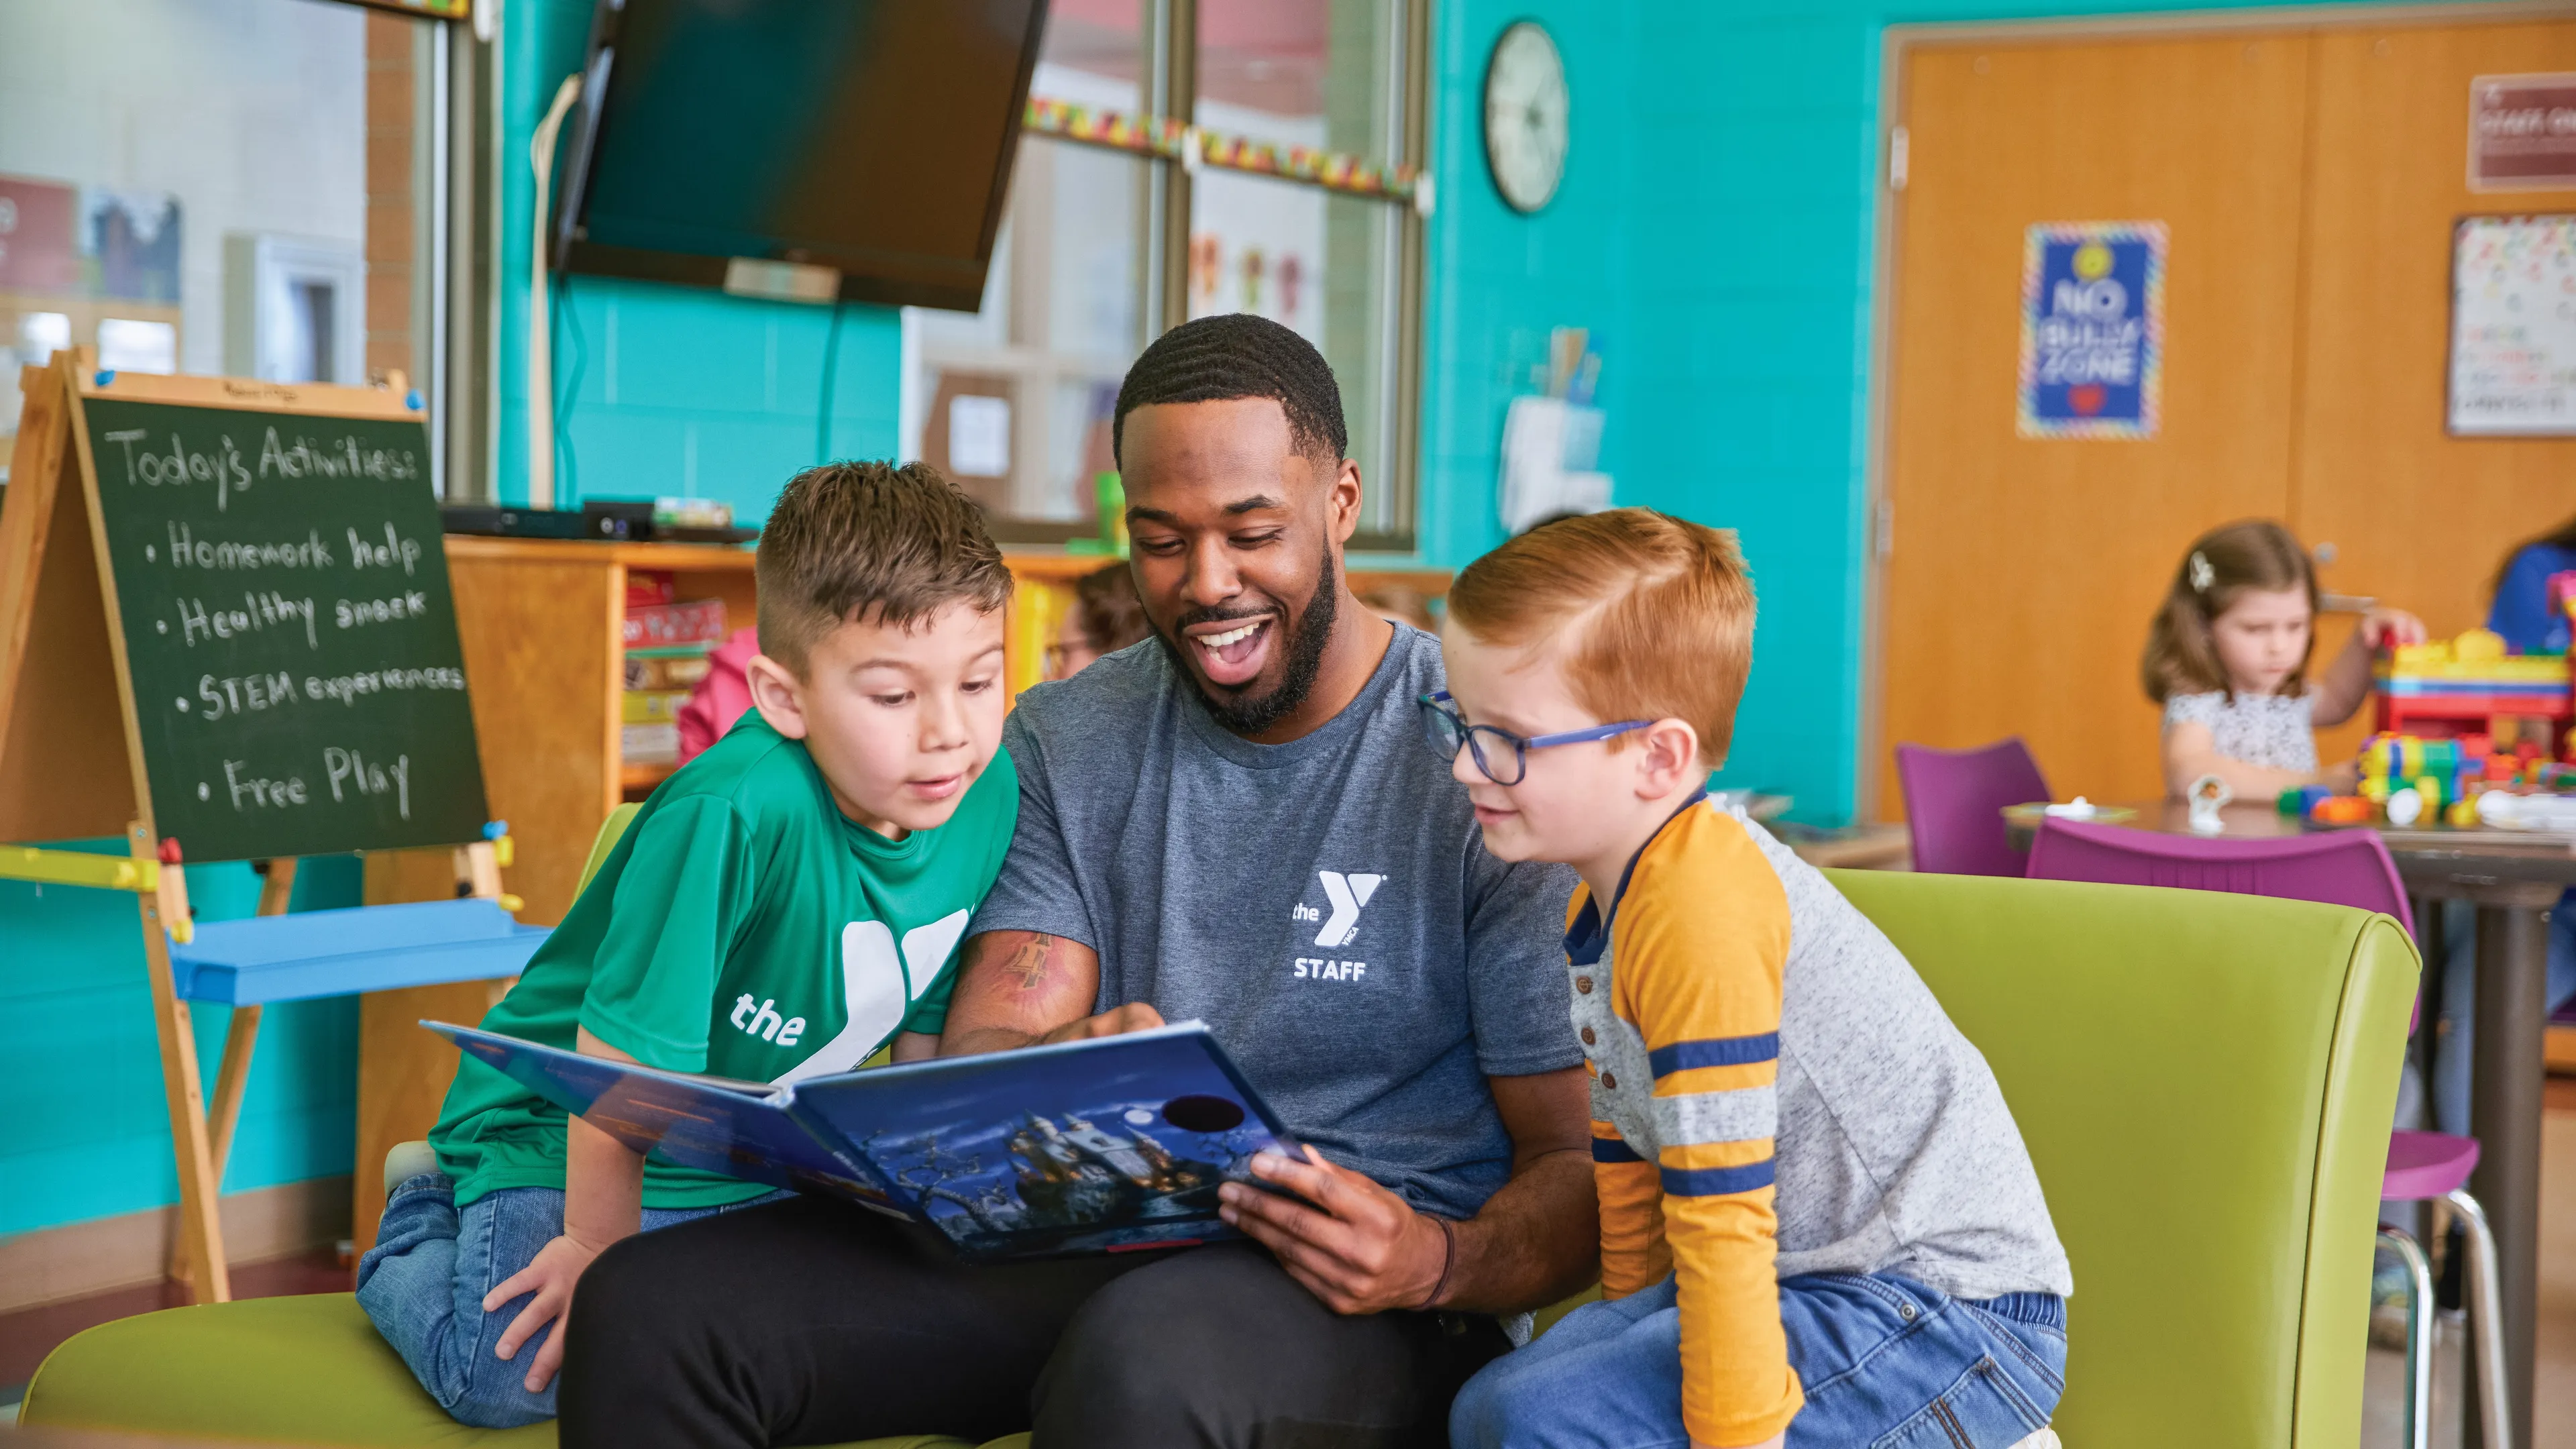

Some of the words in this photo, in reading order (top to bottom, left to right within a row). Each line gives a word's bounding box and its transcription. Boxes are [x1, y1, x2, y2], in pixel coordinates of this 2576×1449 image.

[2053, 278, 2127, 320] NO
[2038, 347, 2137, 384] ZONE
[104, 428, 252, 513] Today's
[167, 519, 334, 571] Homework
[347, 521, 421, 578] help
[176, 590, 318, 650] Healthy
[336, 589, 427, 629] snack
[199, 671, 299, 721] STEM
[305, 667, 467, 707] experiences
[224, 758, 309, 812] Free
[324, 747, 410, 820] Play
[1292, 902, 1320, 921] the
[1341, 926, 1360, 946] YMCA
[1293, 957, 1366, 981] STAFF
[730, 993, 806, 1046] the
